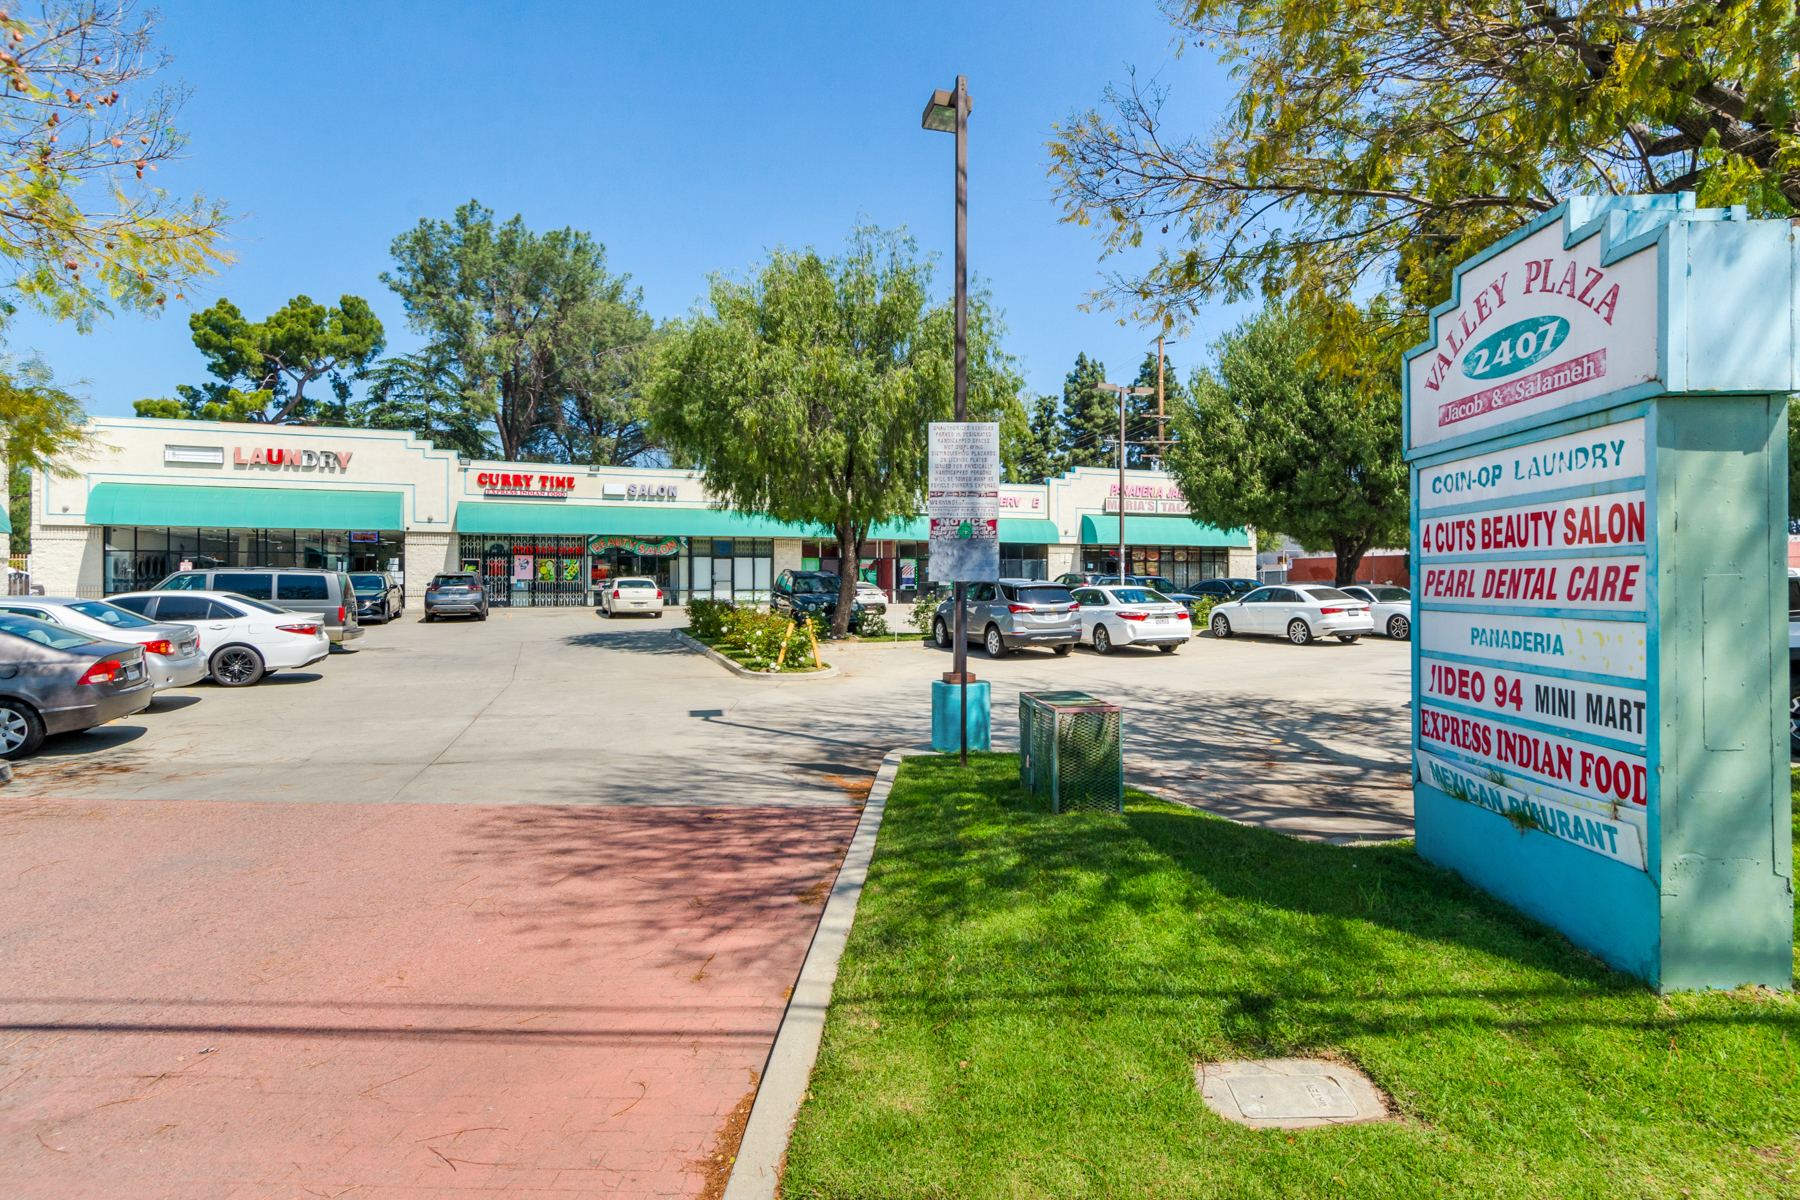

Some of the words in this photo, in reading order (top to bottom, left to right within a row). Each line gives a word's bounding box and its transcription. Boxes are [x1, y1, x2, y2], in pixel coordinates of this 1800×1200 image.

[1424, 271, 1508, 391] VALLEY
[1523, 259, 1620, 326] PLAZA
[1472, 318, 1561, 376] 2407
[1445, 395, 1483, 422] Jacob
[1491, 388, 1504, 407] &
[1515, 356, 1596, 401] Salameh
[234, 447, 353, 469] LAUNDRY
[477, 473, 534, 487] CURRY
[539, 475, 576, 488] TIME
[1432, 464, 1502, 494] COIN-OP
[1514, 439, 1625, 480] LAUNDRY
[628, 484, 678, 497] SALON
[1109, 484, 1164, 498] PANADERIA
[591, 536, 638, 553] BEAUTY
[637, 538, 679, 555] SALON
[1422, 524, 1431, 553] 4
[1435, 519, 1476, 552] CUTS
[1481, 510, 1558, 550] BEAUTY
[1563, 501, 1645, 545] SALON
[513, 545, 555, 554] INDIAN
[558, 546, 585, 555] FOOD
[1424, 569, 1475, 598] PEARL
[1481, 567, 1557, 600] DENTAL
[1566, 564, 1640, 602] CARE
[1471, 627, 1565, 656] PANADERIA
[1494, 675, 1523, 712] 94
[1535, 684, 1576, 720] MINI
[1586, 692, 1646, 735] MART
[1421, 709, 1491, 756] EXPRESS
[1496, 728, 1573, 783] INDIAN
[1579, 751, 1647, 806] FOOD
[1429, 760, 1504, 814] MEXICAN
